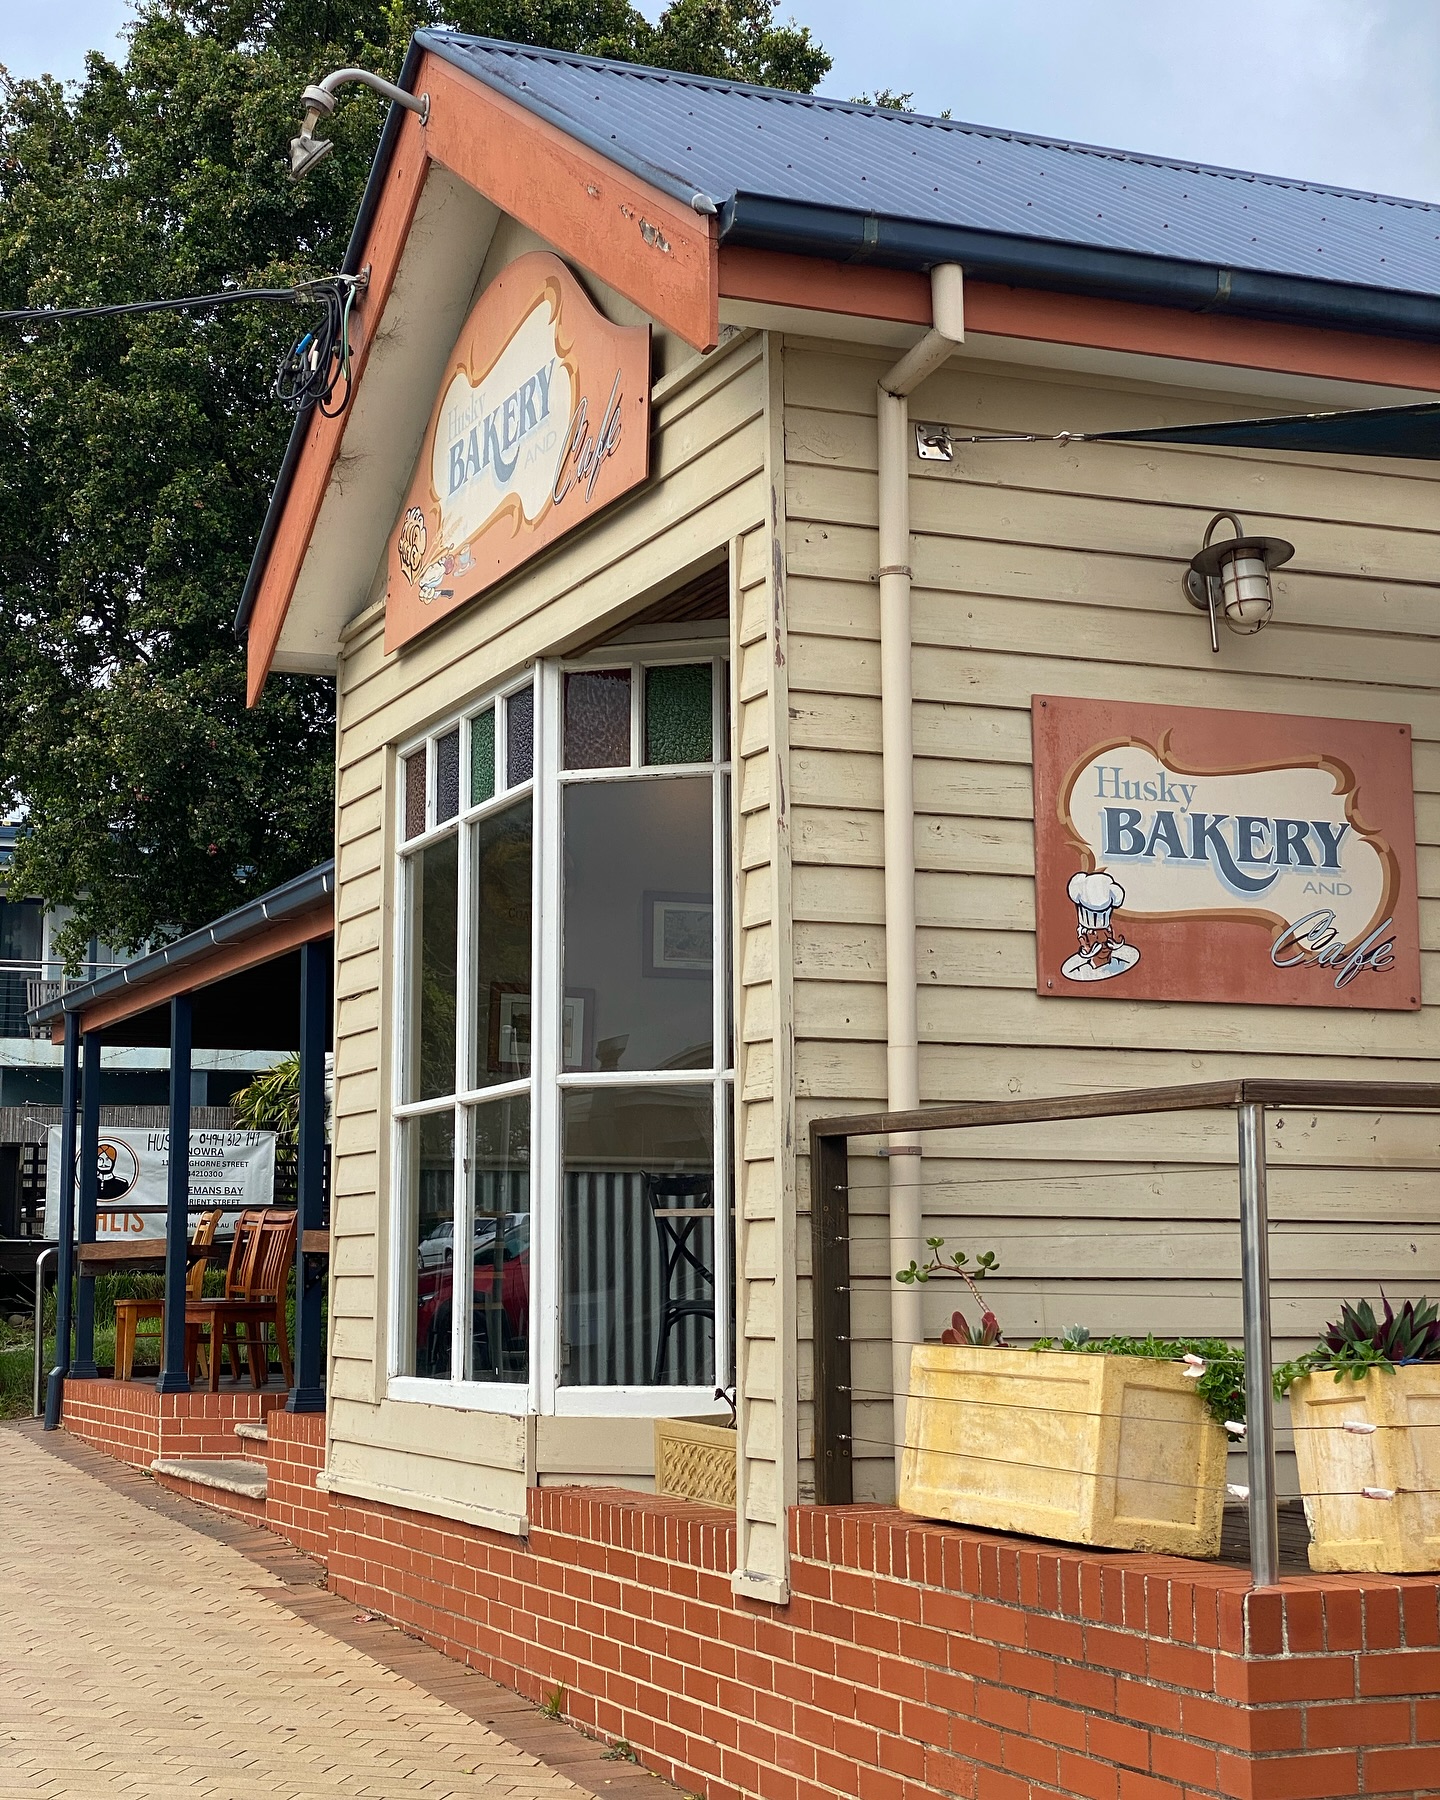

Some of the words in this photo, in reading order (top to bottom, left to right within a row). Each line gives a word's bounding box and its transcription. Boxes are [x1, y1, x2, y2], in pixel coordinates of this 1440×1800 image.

[448, 391, 487, 442] Husky
[448, 357, 556, 496] BAKERY
[524, 430, 558, 470] AND
[1094, 765, 1198, 814] Husky
[1099, 806, 1351, 892] BAKERY
[1302, 881, 1353, 896] AND
[227, 1132, 242, 1147] 312
[224, 1186, 244, 1195] BAY
